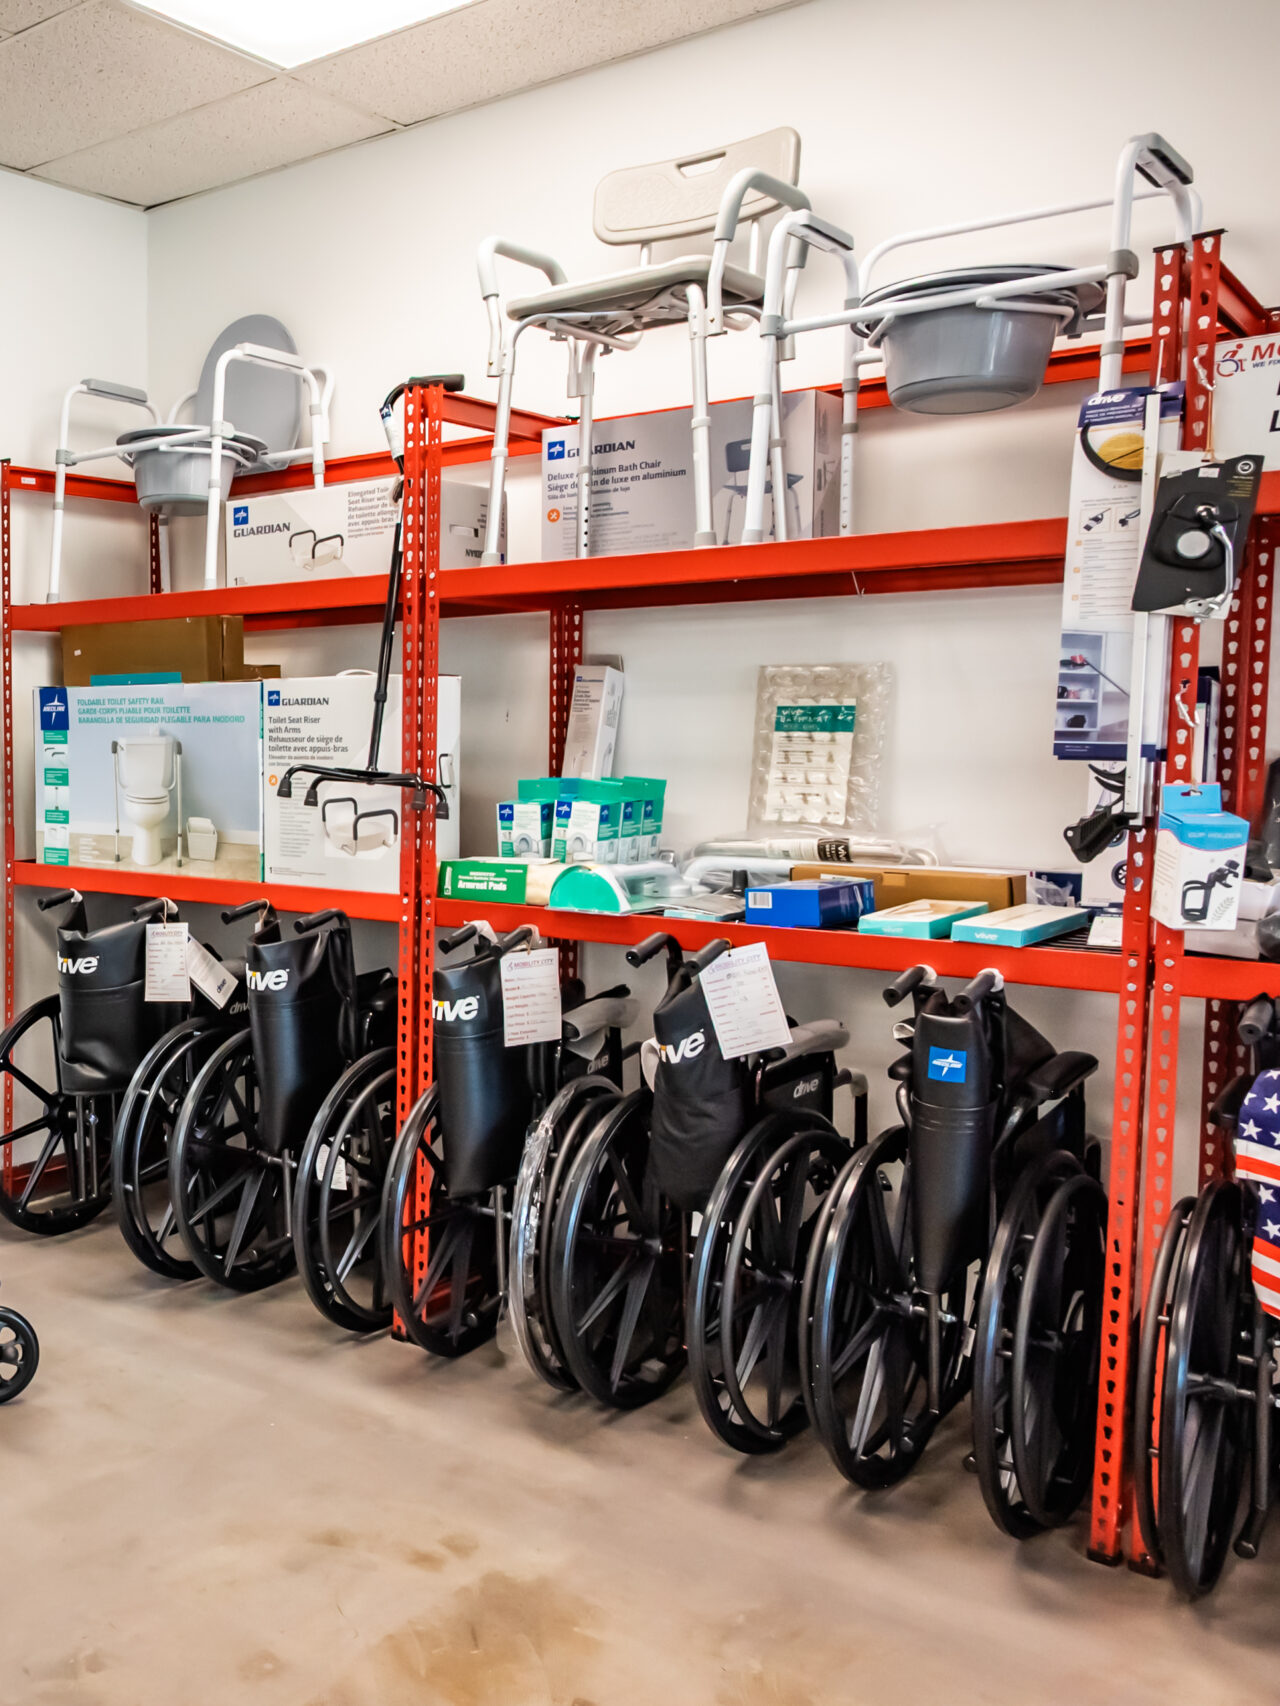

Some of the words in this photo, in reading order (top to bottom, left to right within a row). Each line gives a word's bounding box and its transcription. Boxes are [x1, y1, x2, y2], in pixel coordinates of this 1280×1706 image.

[1087, 394, 1125, 405] drive
[567, 440, 636, 458] GRDIAN
[547, 472, 574, 482] Deluxe
[618, 464, 638, 473] Bath
[639, 460, 662, 470] Chair
[547, 483, 569, 493] Siège
[600, 478, 610, 486] de
[611, 475, 629, 484] luxe
[630, 474, 641, 482] en
[642, 469, 687, 481] aluminium
[233, 522, 291, 538] GUARDIAN
[77, 697, 106, 707] FOLDABLE
[107, 698, 126, 706] TOILET
[127, 697, 149, 706] SAFETY
[150, 697, 164, 705] RAIL
[281, 697, 330, 706] GUARDIAN
[78, 707, 118, 715] GARDE-CORPS
[118, 707, 142, 715] PLIABLE
[143, 706, 161, 714] POUR
[162, 706, 191, 714] TOILETTE
[115, 716, 124, 724] DE
[193, 715, 211, 723] PARA
[212, 715, 245, 723] INODORO
[269, 716, 287, 724] Toilet
[288, 716, 303, 724] Seat
[304, 716, 320, 724] Riser
[269, 726, 283, 734] with
[307, 735, 315, 743] de
[316, 735, 333, 746] siège
[334, 735, 343, 743] de
[269, 744, 292, 752] toilette
[457, 880, 488, 890] Armrest
[488, 882, 507, 892] Pads
[974, 932, 999, 941] vive
[586, 1053, 609, 1074] drive
[793, 1078, 819, 1099] drive
